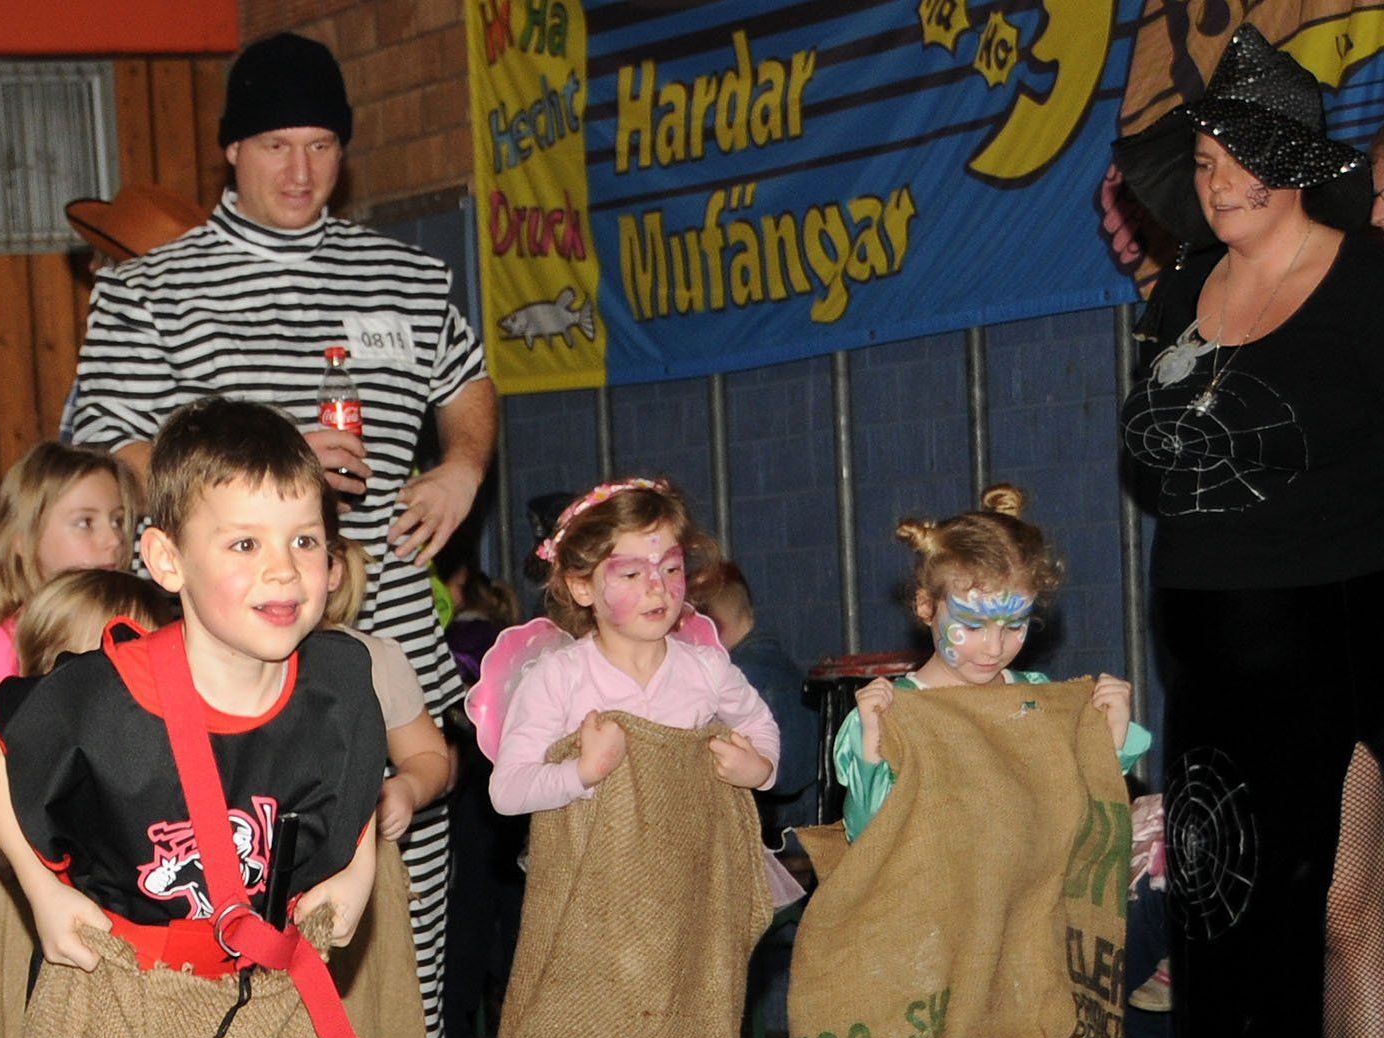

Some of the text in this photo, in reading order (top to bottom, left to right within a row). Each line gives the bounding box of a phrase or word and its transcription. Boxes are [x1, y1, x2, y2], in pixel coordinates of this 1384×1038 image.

[487, 68, 580, 174] Hecht
[615, 29, 817, 174] Hardar
[489, 188, 587, 262] Druck
[617, 183, 916, 323] Mufängar
